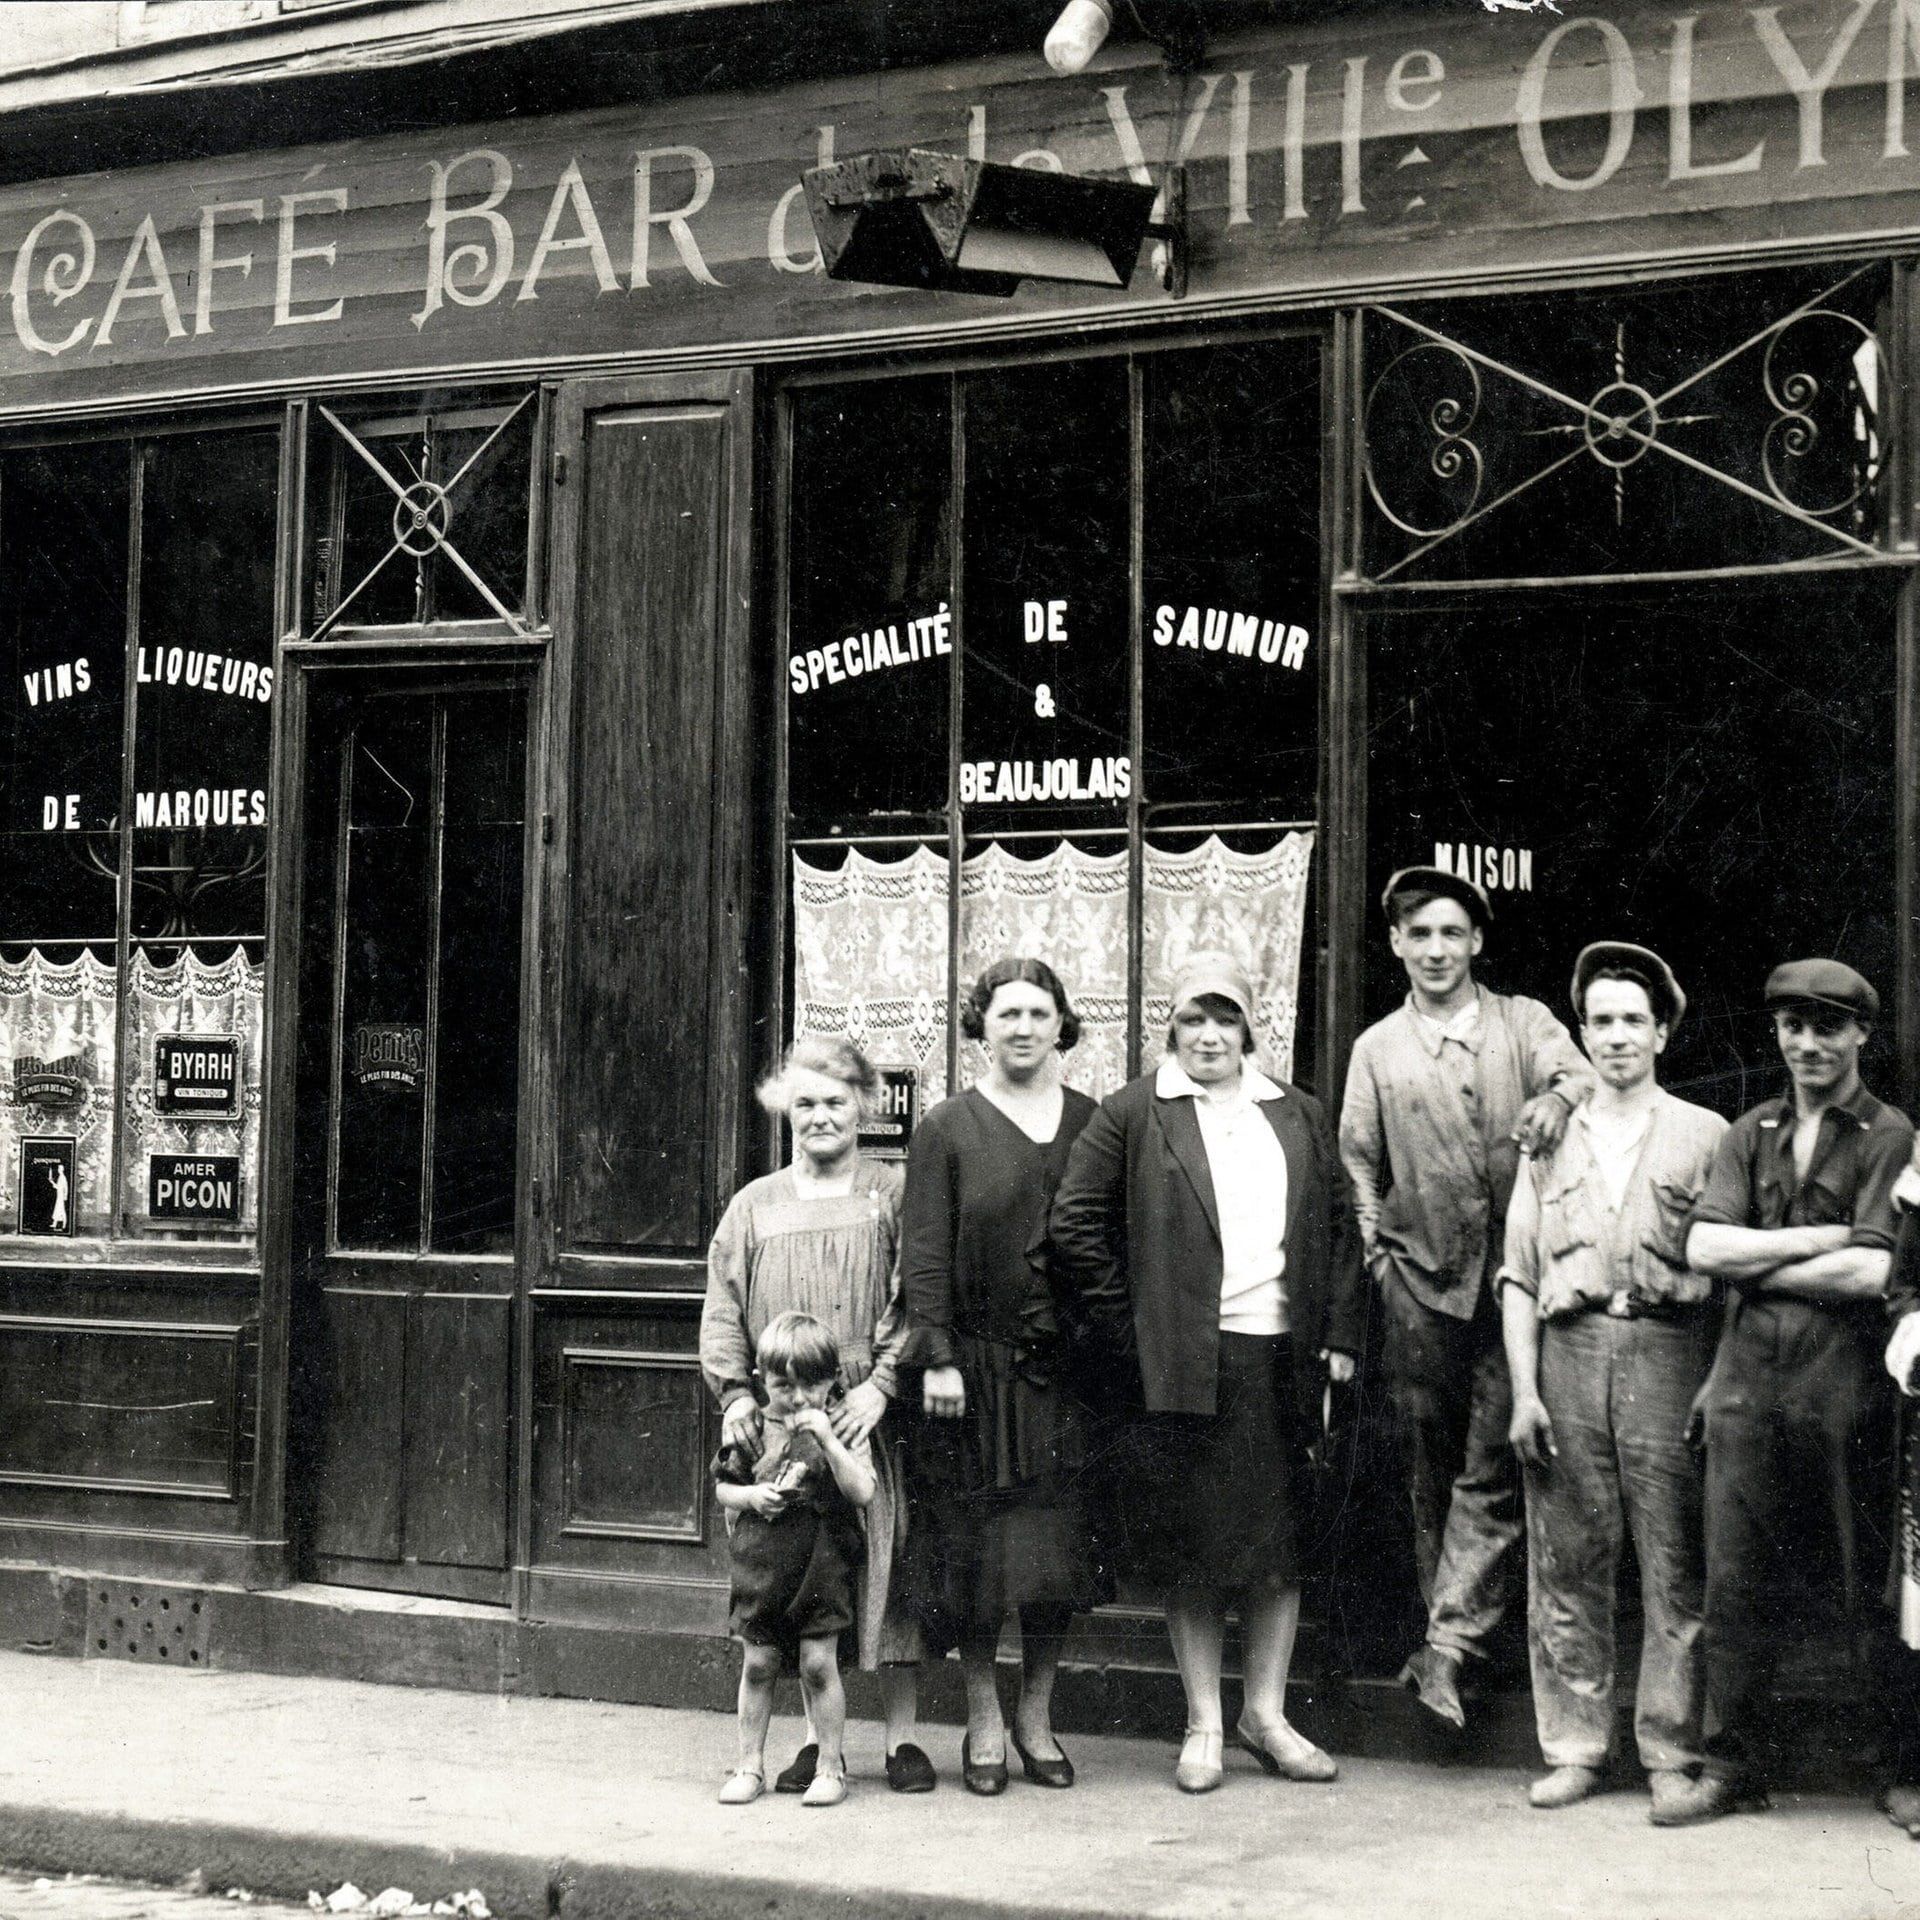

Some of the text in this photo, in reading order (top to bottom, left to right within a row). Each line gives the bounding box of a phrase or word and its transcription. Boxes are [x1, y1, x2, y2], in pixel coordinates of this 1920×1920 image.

[2, 163, 348, 355] CAFÉ
[410, 146, 731, 332] BAR
[789, 600, 1309, 694] SPECIALITÉ DE SAUMUR
[24, 646, 274, 706] VINS LIQUEURS
[1035, 683, 1056, 718] &
[960, 756, 1131, 803] BEAUJOLAIS
[43, 788, 266, 831] DE MARQUES
[1434, 841, 1533, 893] MAISON
[171, 1052, 233, 1080] BYRRH
[192, 1088, 223, 1097] TONIQUE
[173, 1163, 216, 1177] AMER
[157, 1179, 232, 1210] PICON
